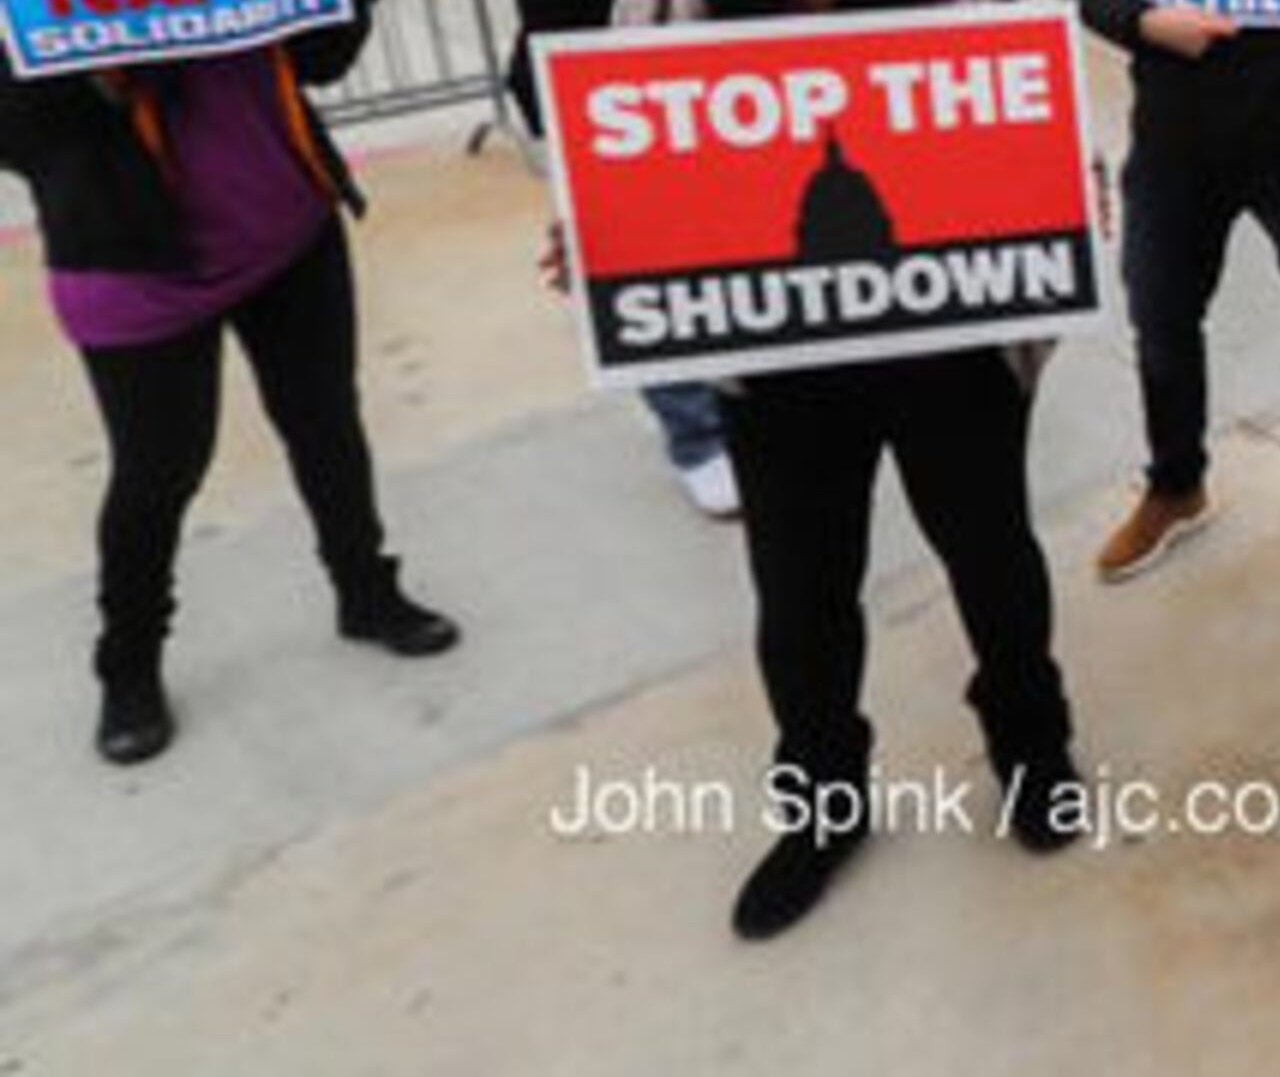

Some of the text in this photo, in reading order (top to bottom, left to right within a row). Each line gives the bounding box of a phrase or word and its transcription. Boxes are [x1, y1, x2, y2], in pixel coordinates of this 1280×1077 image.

[586, 52, 1053, 159] STOP THE
[613, 240, 1076, 347] SHUTDOWN
